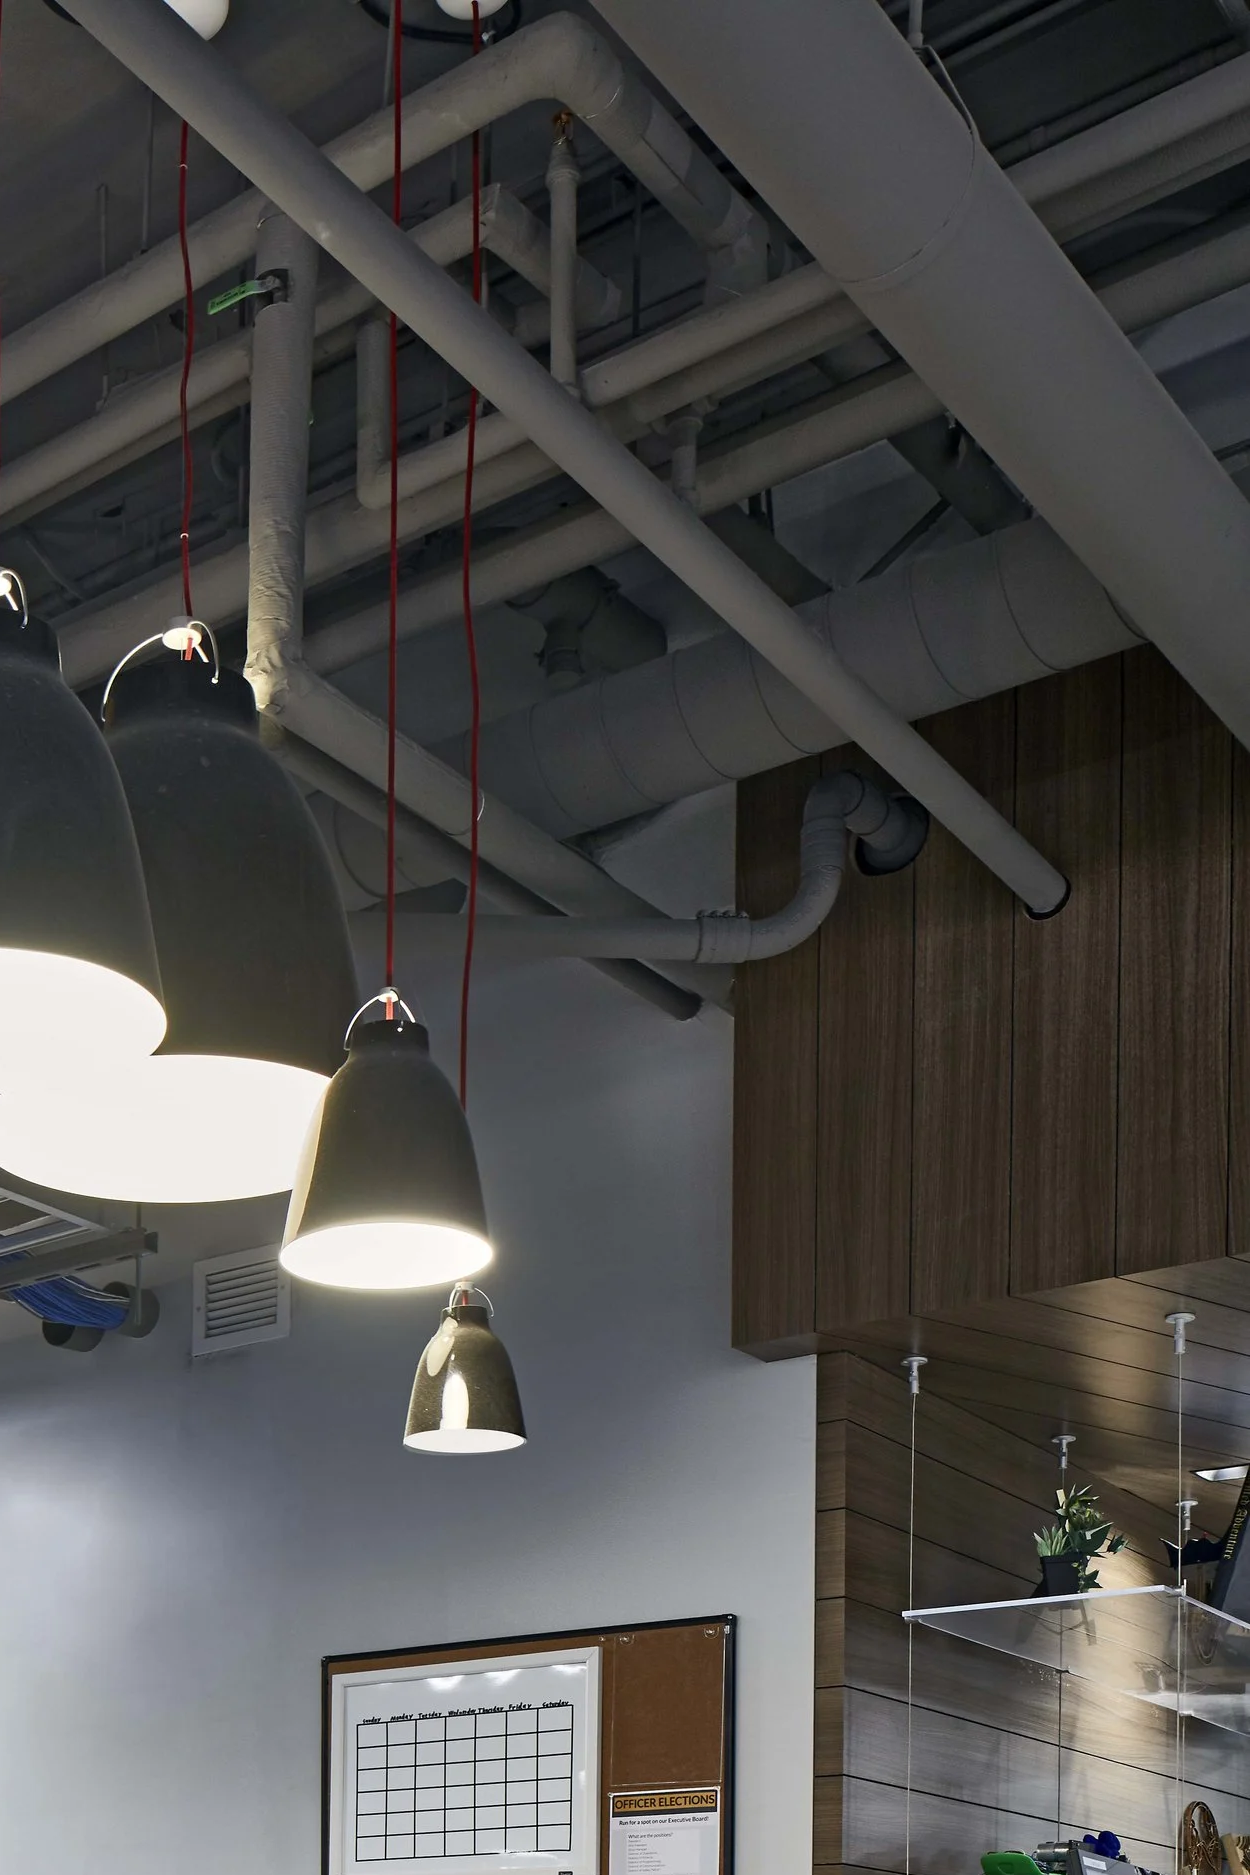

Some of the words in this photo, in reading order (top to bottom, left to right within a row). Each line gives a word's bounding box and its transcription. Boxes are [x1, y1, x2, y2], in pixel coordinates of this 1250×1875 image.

[1223, 1509, 1248, 1560] Adventure
[509, 1702, 532, 1710] Friday
[615, 1798, 656, 1810] OFFICER
[659, 1794, 715, 1807] ELECTIONS
